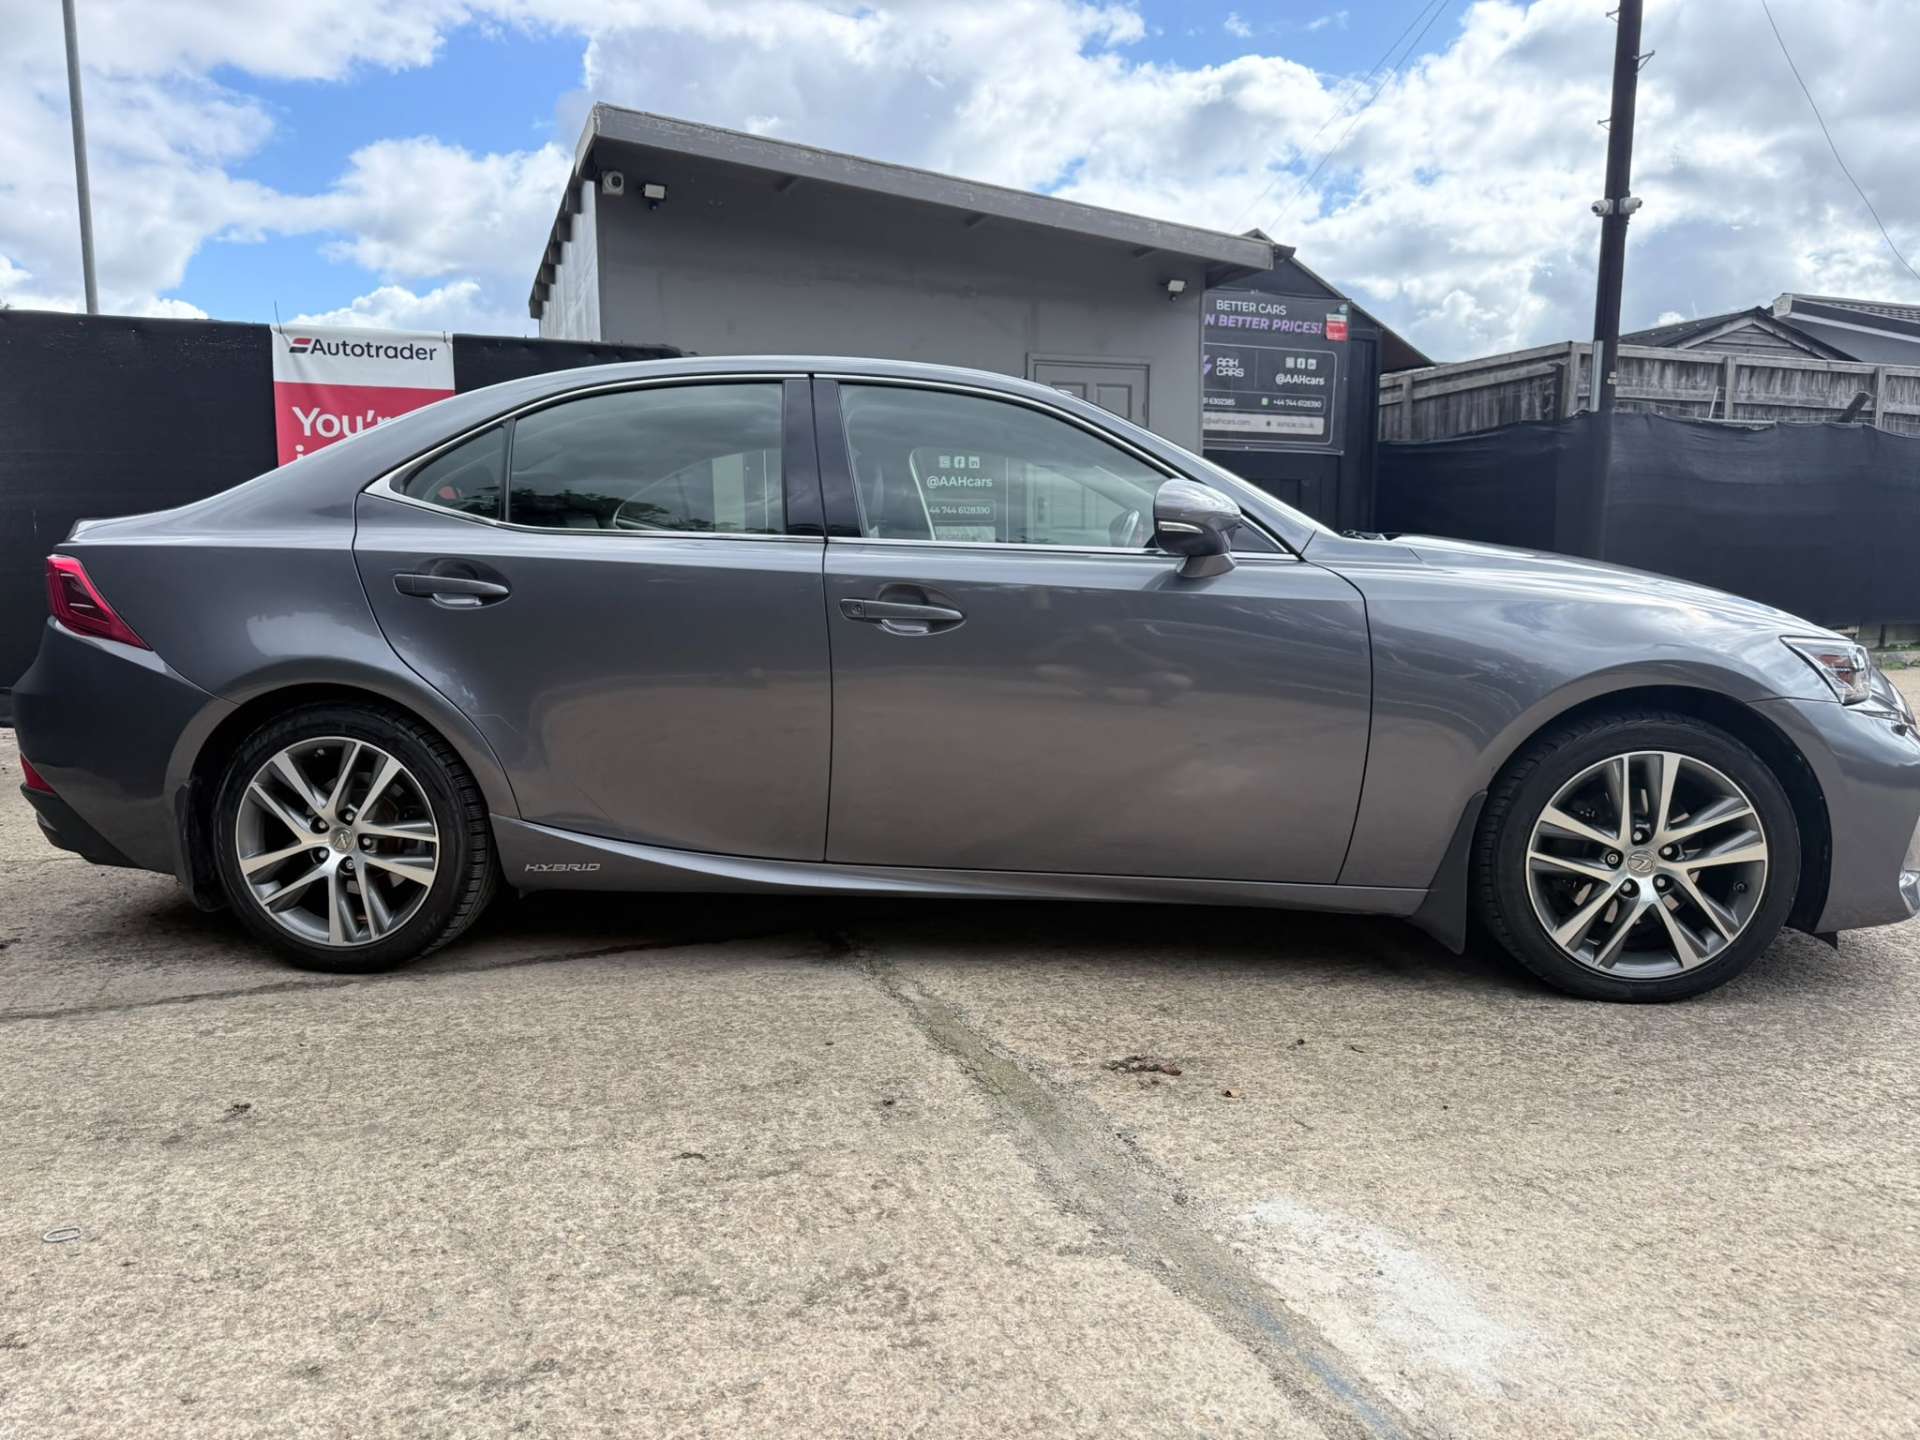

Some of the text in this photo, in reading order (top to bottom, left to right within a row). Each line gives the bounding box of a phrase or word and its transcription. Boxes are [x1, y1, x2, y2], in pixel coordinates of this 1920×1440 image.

[1216, 300, 1287, 315] BETTER CARS
[1218, 315, 1269, 330] BETTER
[1271, 321, 1322, 334] PRICES!
[310, 338, 437, 361] Autotrader
[1216, 366, 1244, 377] CARS
[1275, 373, 1325, 386] @AAHcars
[926, 475, 993, 488] @AAHcars
[524, 863, 601, 873] HYBRID
